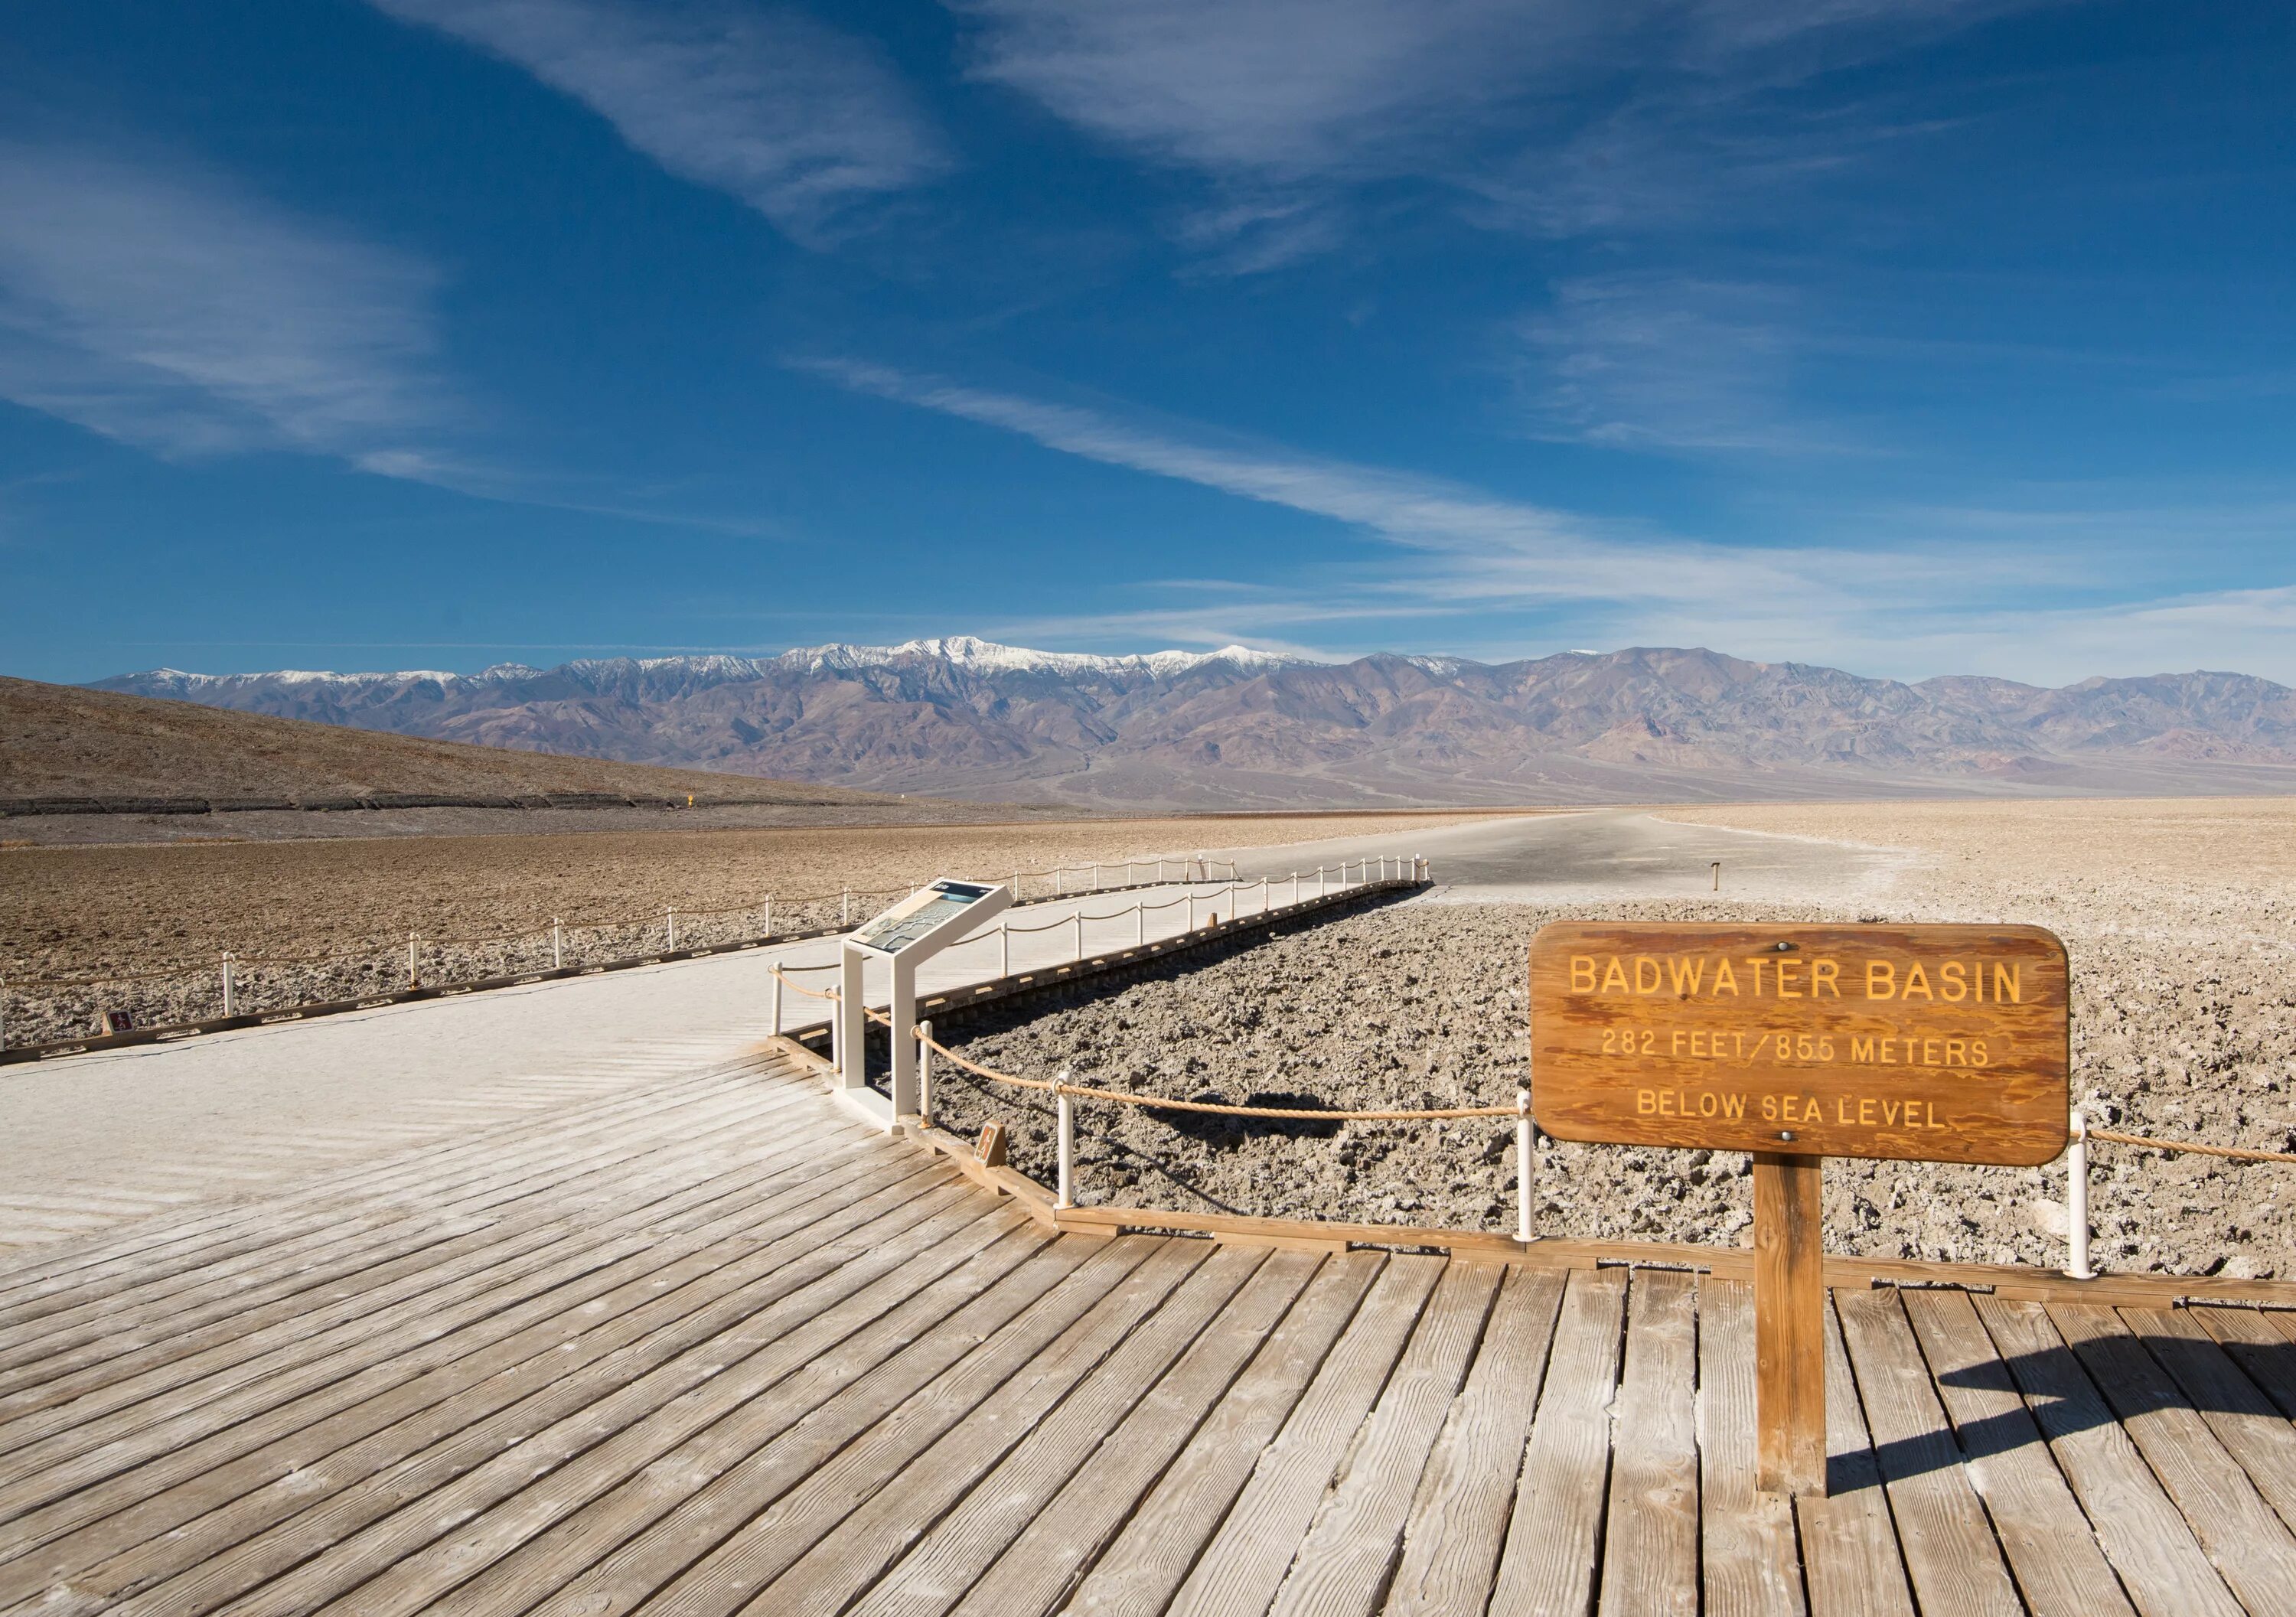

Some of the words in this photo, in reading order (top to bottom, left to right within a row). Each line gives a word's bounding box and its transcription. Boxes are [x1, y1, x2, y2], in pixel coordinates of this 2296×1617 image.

[1570, 954, 1841, 999] BADWATER
[1866, 960, 2021, 1004] BASIN
[1601, 1030, 1656, 1055] 282
[1851, 1038, 1989, 1068] METERS
[1636, 1090, 1747, 1118] BELOW
[1762, 1094, 1824, 1123] SEA
[1838, 1099, 1946, 1129] LEVEL
